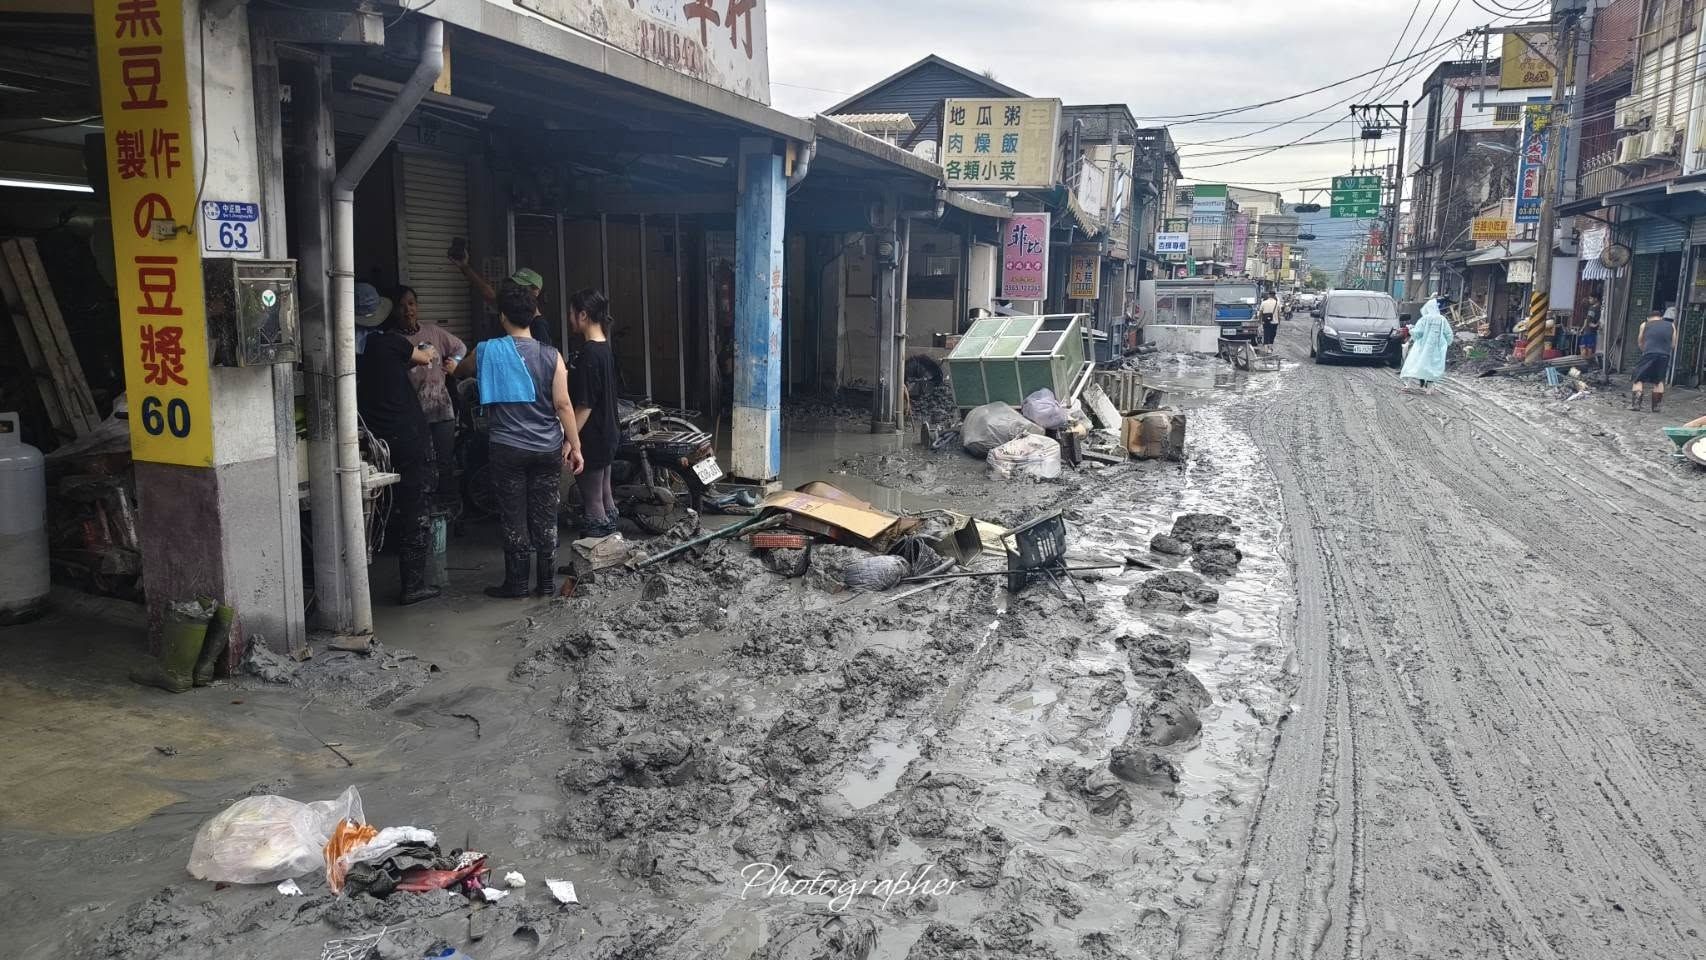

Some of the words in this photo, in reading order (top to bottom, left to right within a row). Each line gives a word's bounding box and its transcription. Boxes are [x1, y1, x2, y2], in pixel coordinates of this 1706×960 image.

[949, 105, 1021, 126] 地瓜粥
[947, 133, 1019, 153] 肉燥飯
[946, 160, 1017, 181] 各類小菜
[219, 221, 249, 249] 63
[1007, 223, 1043, 257] 菲比
[141, 396, 191, 438] 60
